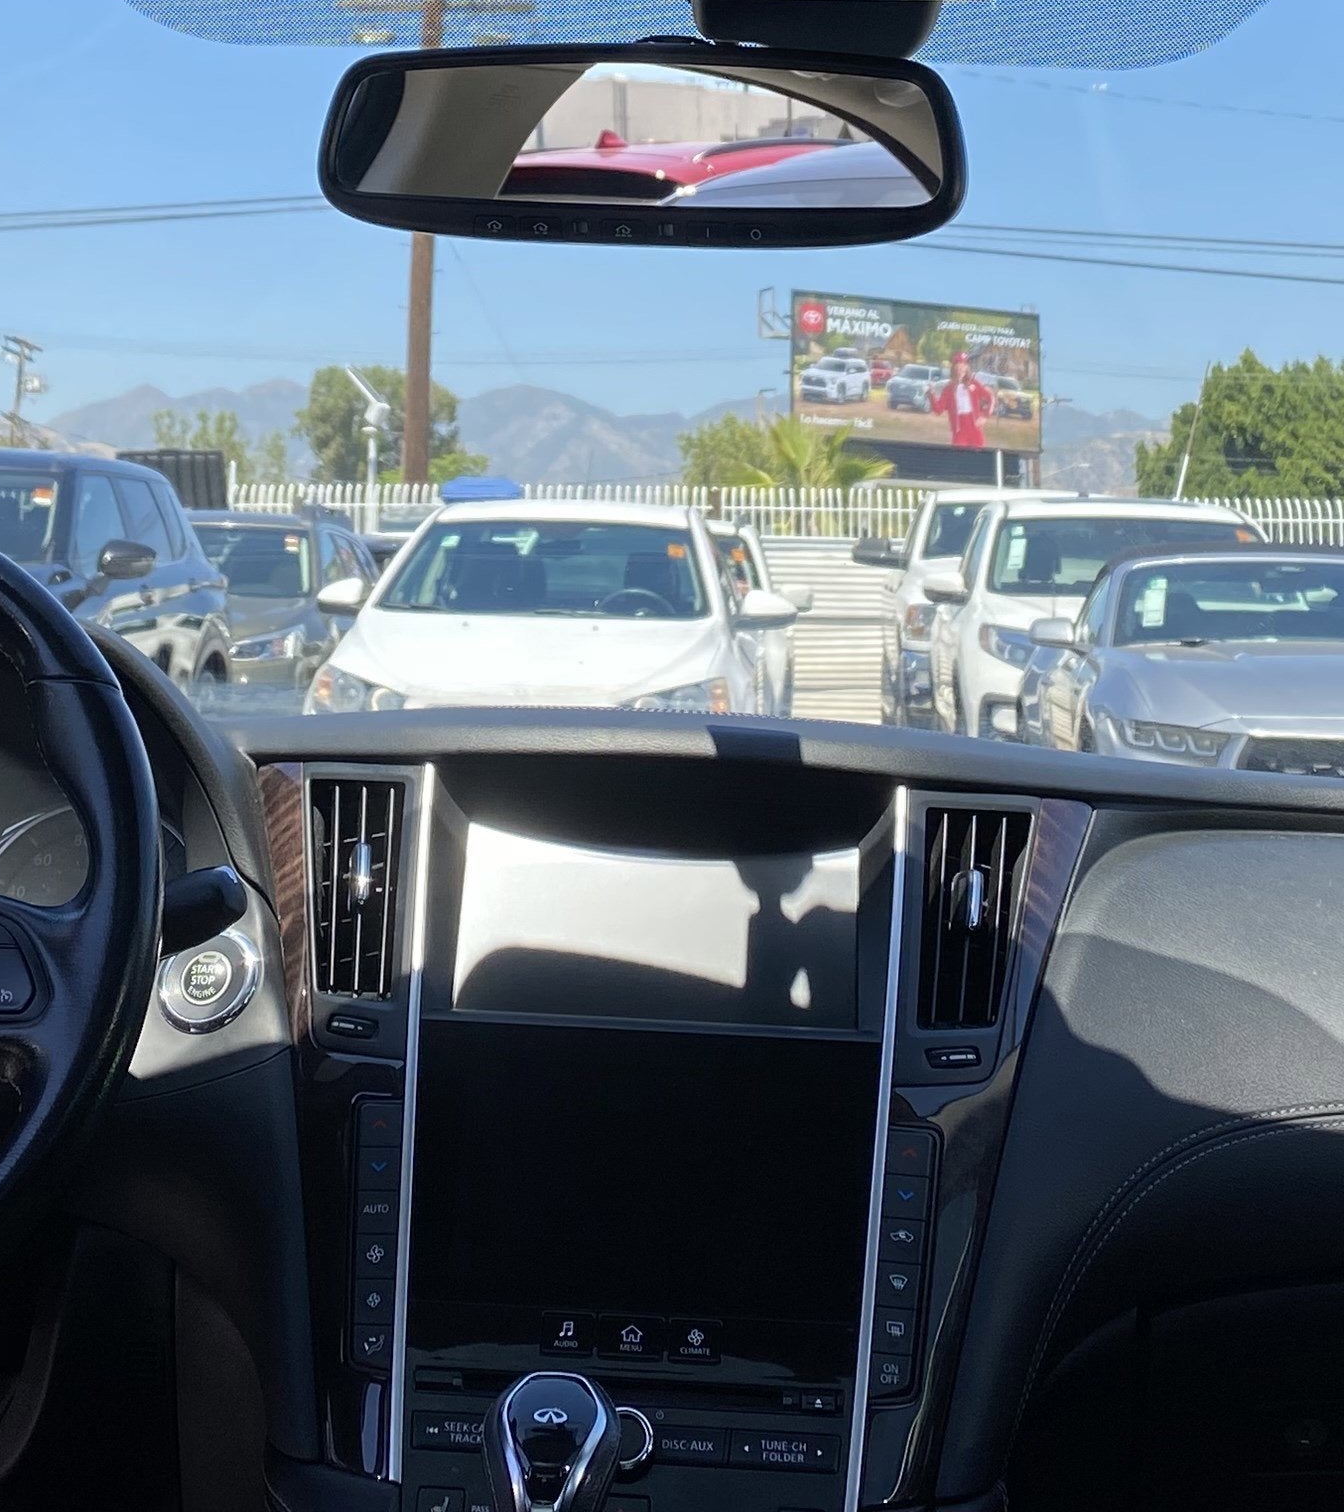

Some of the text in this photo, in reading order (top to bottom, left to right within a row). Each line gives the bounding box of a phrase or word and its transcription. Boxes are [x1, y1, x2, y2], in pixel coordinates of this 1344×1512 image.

[827, 305, 880, 319] VERANO AL
[34, 854, 52, 866] 60
[190, 976, 215, 986] STOP
[187, 986, 217, 998] ENGINE
[363, 1203, 389, 1214] AUTO
[553, 1339, 578, 1348] AUDIO
[619, 1343, 643, 1352] MENU
[679, 1346, 710, 1356] CLIMATE
[882, 1363, 899, 1375] ON
[880, 1374, 900, 1386] OFF
[443, 1421, 469, 1433] SEEK
[449, 1433, 482, 1444] TRACK
[762, 1451, 804, 1463] FOLDER
